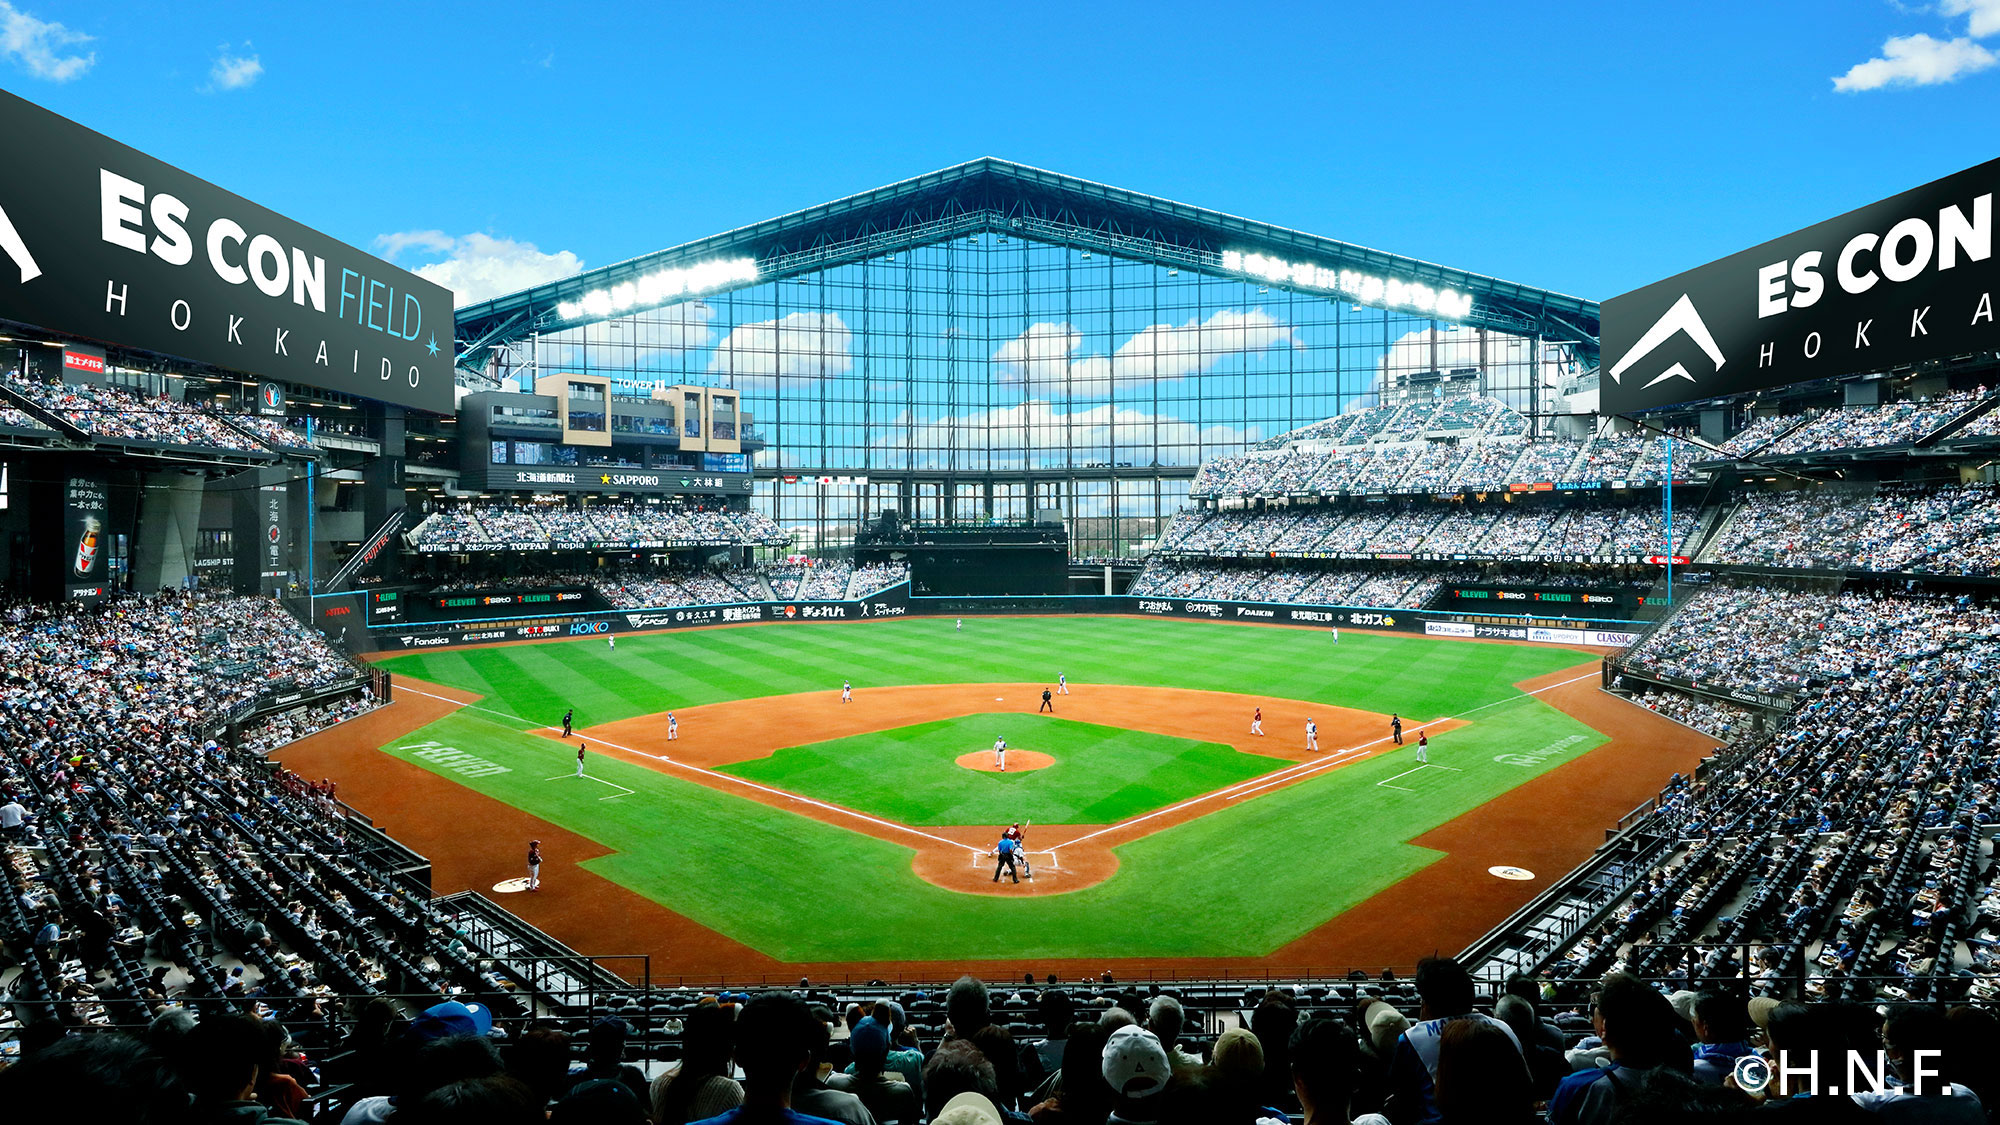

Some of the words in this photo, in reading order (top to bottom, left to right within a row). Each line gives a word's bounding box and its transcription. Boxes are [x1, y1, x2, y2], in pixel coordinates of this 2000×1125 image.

[100, 168, 193, 266] ES
[206, 218, 325, 312] CON
[339, 268, 422, 341] FIELD
[1759, 251, 1825, 319] ES
[1837, 193, 1992, 294] CON
[106, 280, 420, 388] HOKKAIDO
[1759, 293, 1993, 368] HOKKA
[617, 378, 653, 390] TOWER
[655, 380, 666, 392] 11
[516, 472, 575, 483] 北海道新聞社
[612, 475, 659, 486] SAPPORO
[693, 478, 723, 487] 大林組
[364, 533, 390, 564] FUJITEC
[557, 542, 585, 550] nepia
[376, 593, 397, 602] 7-ELEVEN
[441, 598, 476, 607] 7-ELEVEN
[518, 595, 550, 603] 7-ELEVEN
[1454, 590, 1488, 599] 7-ELEVEN
[1534, 593, 1571, 602] 7-ELEVEN
[802, 606, 845, 618] ぎょれん
[874, 608, 905, 616] スーパードライ
[1139, 601, 1173, 611] まつおかまん
[1194, 604, 1223, 613] オカモト
[722, 608, 743, 622] 東進
[1350, 612, 1384, 625] 北ガス
[523, 625, 560, 634] KOTOBUKI
[1476, 627, 1526, 638] ナラサキ産業
[414, 637, 450, 646] Fanatics
[1597, 632, 1632, 644] CLASSIC
[276, 693, 301, 704] Panasonic
[1731, 690, 1757, 702] docomo
